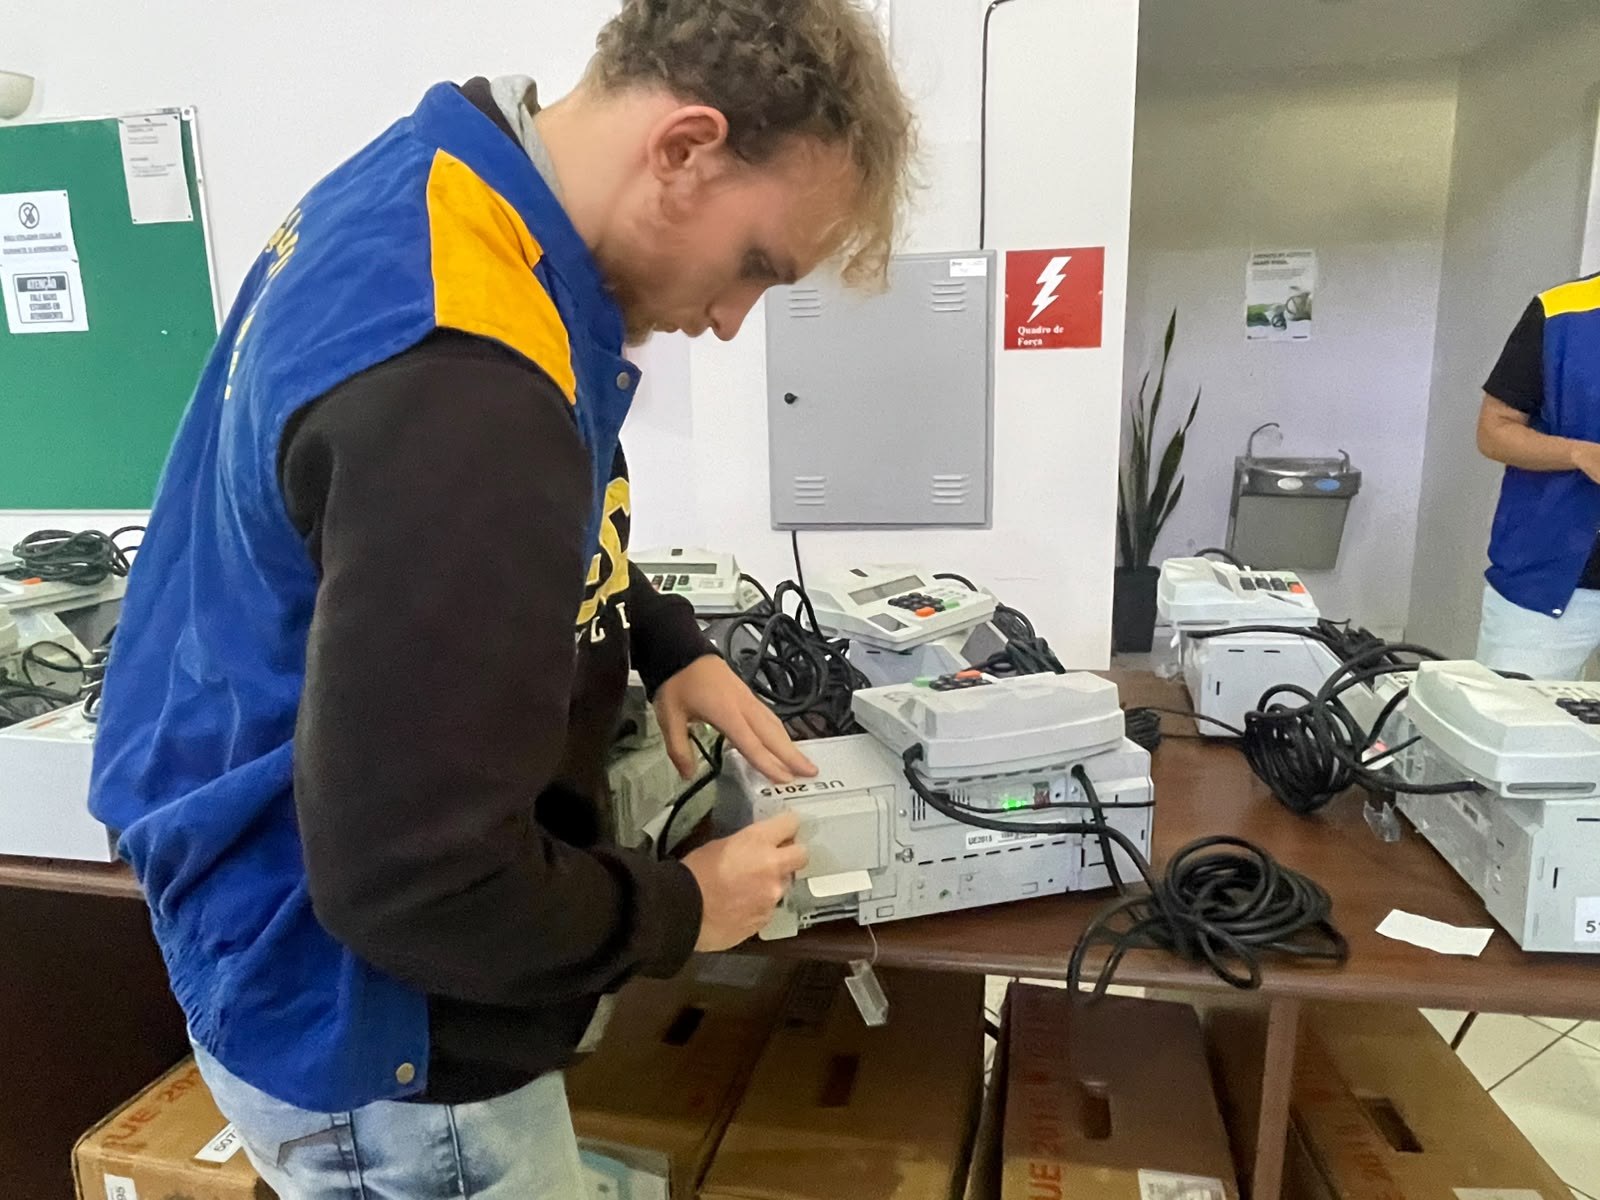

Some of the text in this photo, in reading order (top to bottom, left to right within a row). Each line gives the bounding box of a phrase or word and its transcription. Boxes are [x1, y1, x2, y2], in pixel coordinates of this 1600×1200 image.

[1017, 325, 1064, 336] Quadro de
[1017, 337, 1043, 347] Força
[760, 780, 845, 797] UE 2015
[1585, 920, 1600, 934] 5
